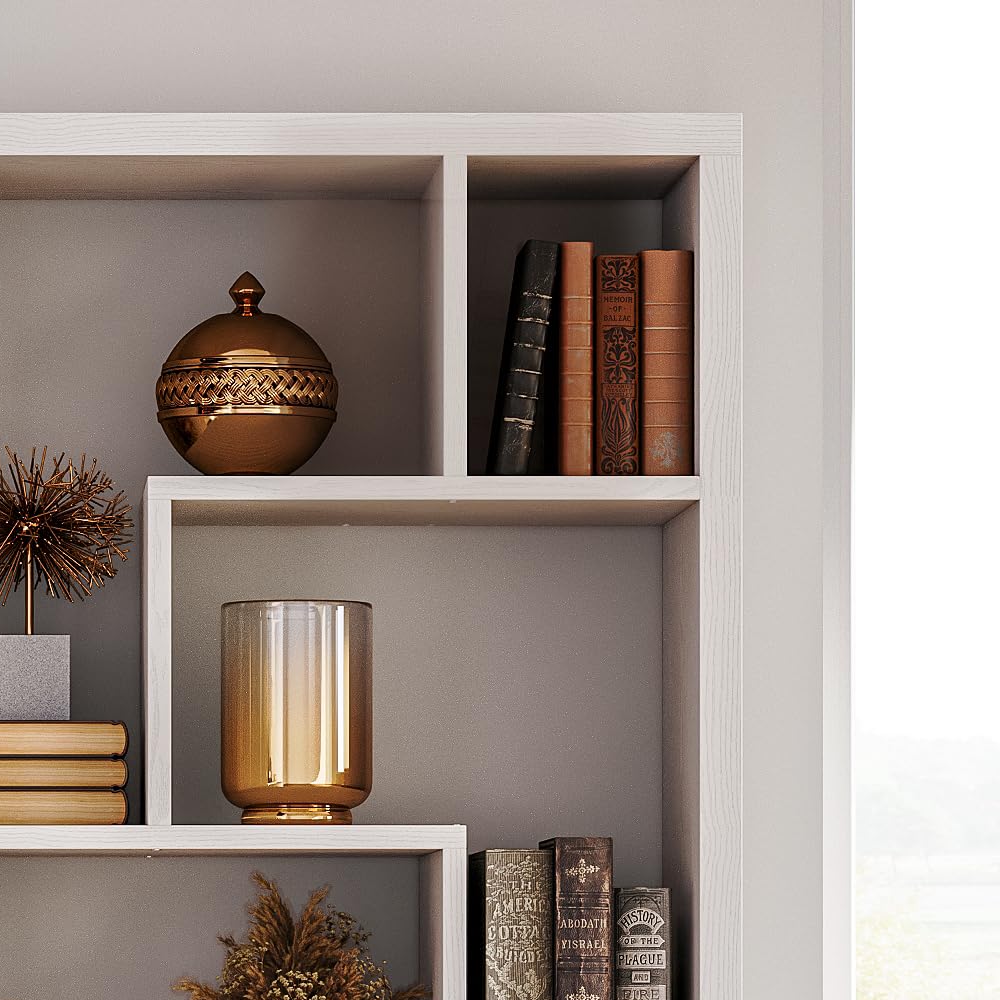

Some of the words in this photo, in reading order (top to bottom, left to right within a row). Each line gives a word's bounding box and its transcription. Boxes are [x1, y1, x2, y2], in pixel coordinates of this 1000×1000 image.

[620, 909, 661, 929] HISTORY
[561, 939, 607, 949] YISRAEL
[624, 937, 636, 945] OF
[641, 937, 659, 945] THE
[618, 953, 664, 966] PLAGUE
[633, 973, 649, 981] AND
[622, 989, 660, 1000] FIRE
